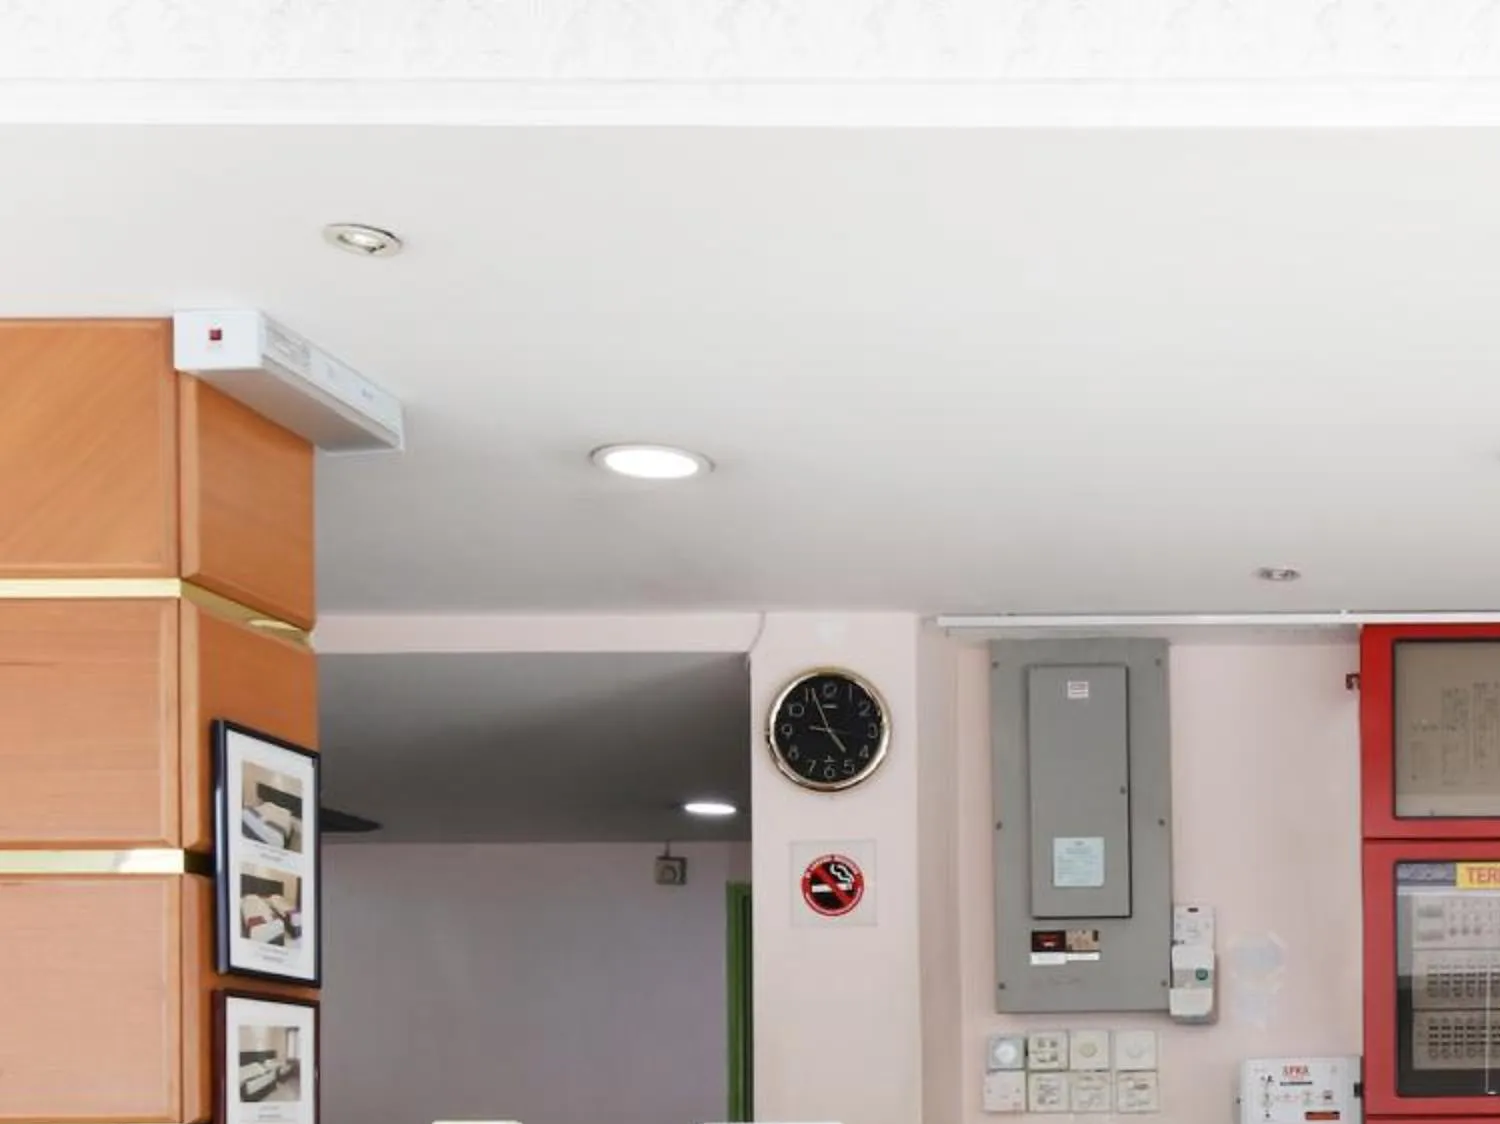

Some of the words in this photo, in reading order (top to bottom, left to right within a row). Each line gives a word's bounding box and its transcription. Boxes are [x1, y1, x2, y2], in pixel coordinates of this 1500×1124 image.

[858, 701, 872, 717] 2
[781, 723, 793, 739] 9
[867, 722, 879, 739] 3
[788, 744, 800, 760] 8
[859, 744, 870, 759] 4
[807, 759, 818, 776] 7
[823, 763, 836, 780] 6
[842, 759, 855, 774] 5
